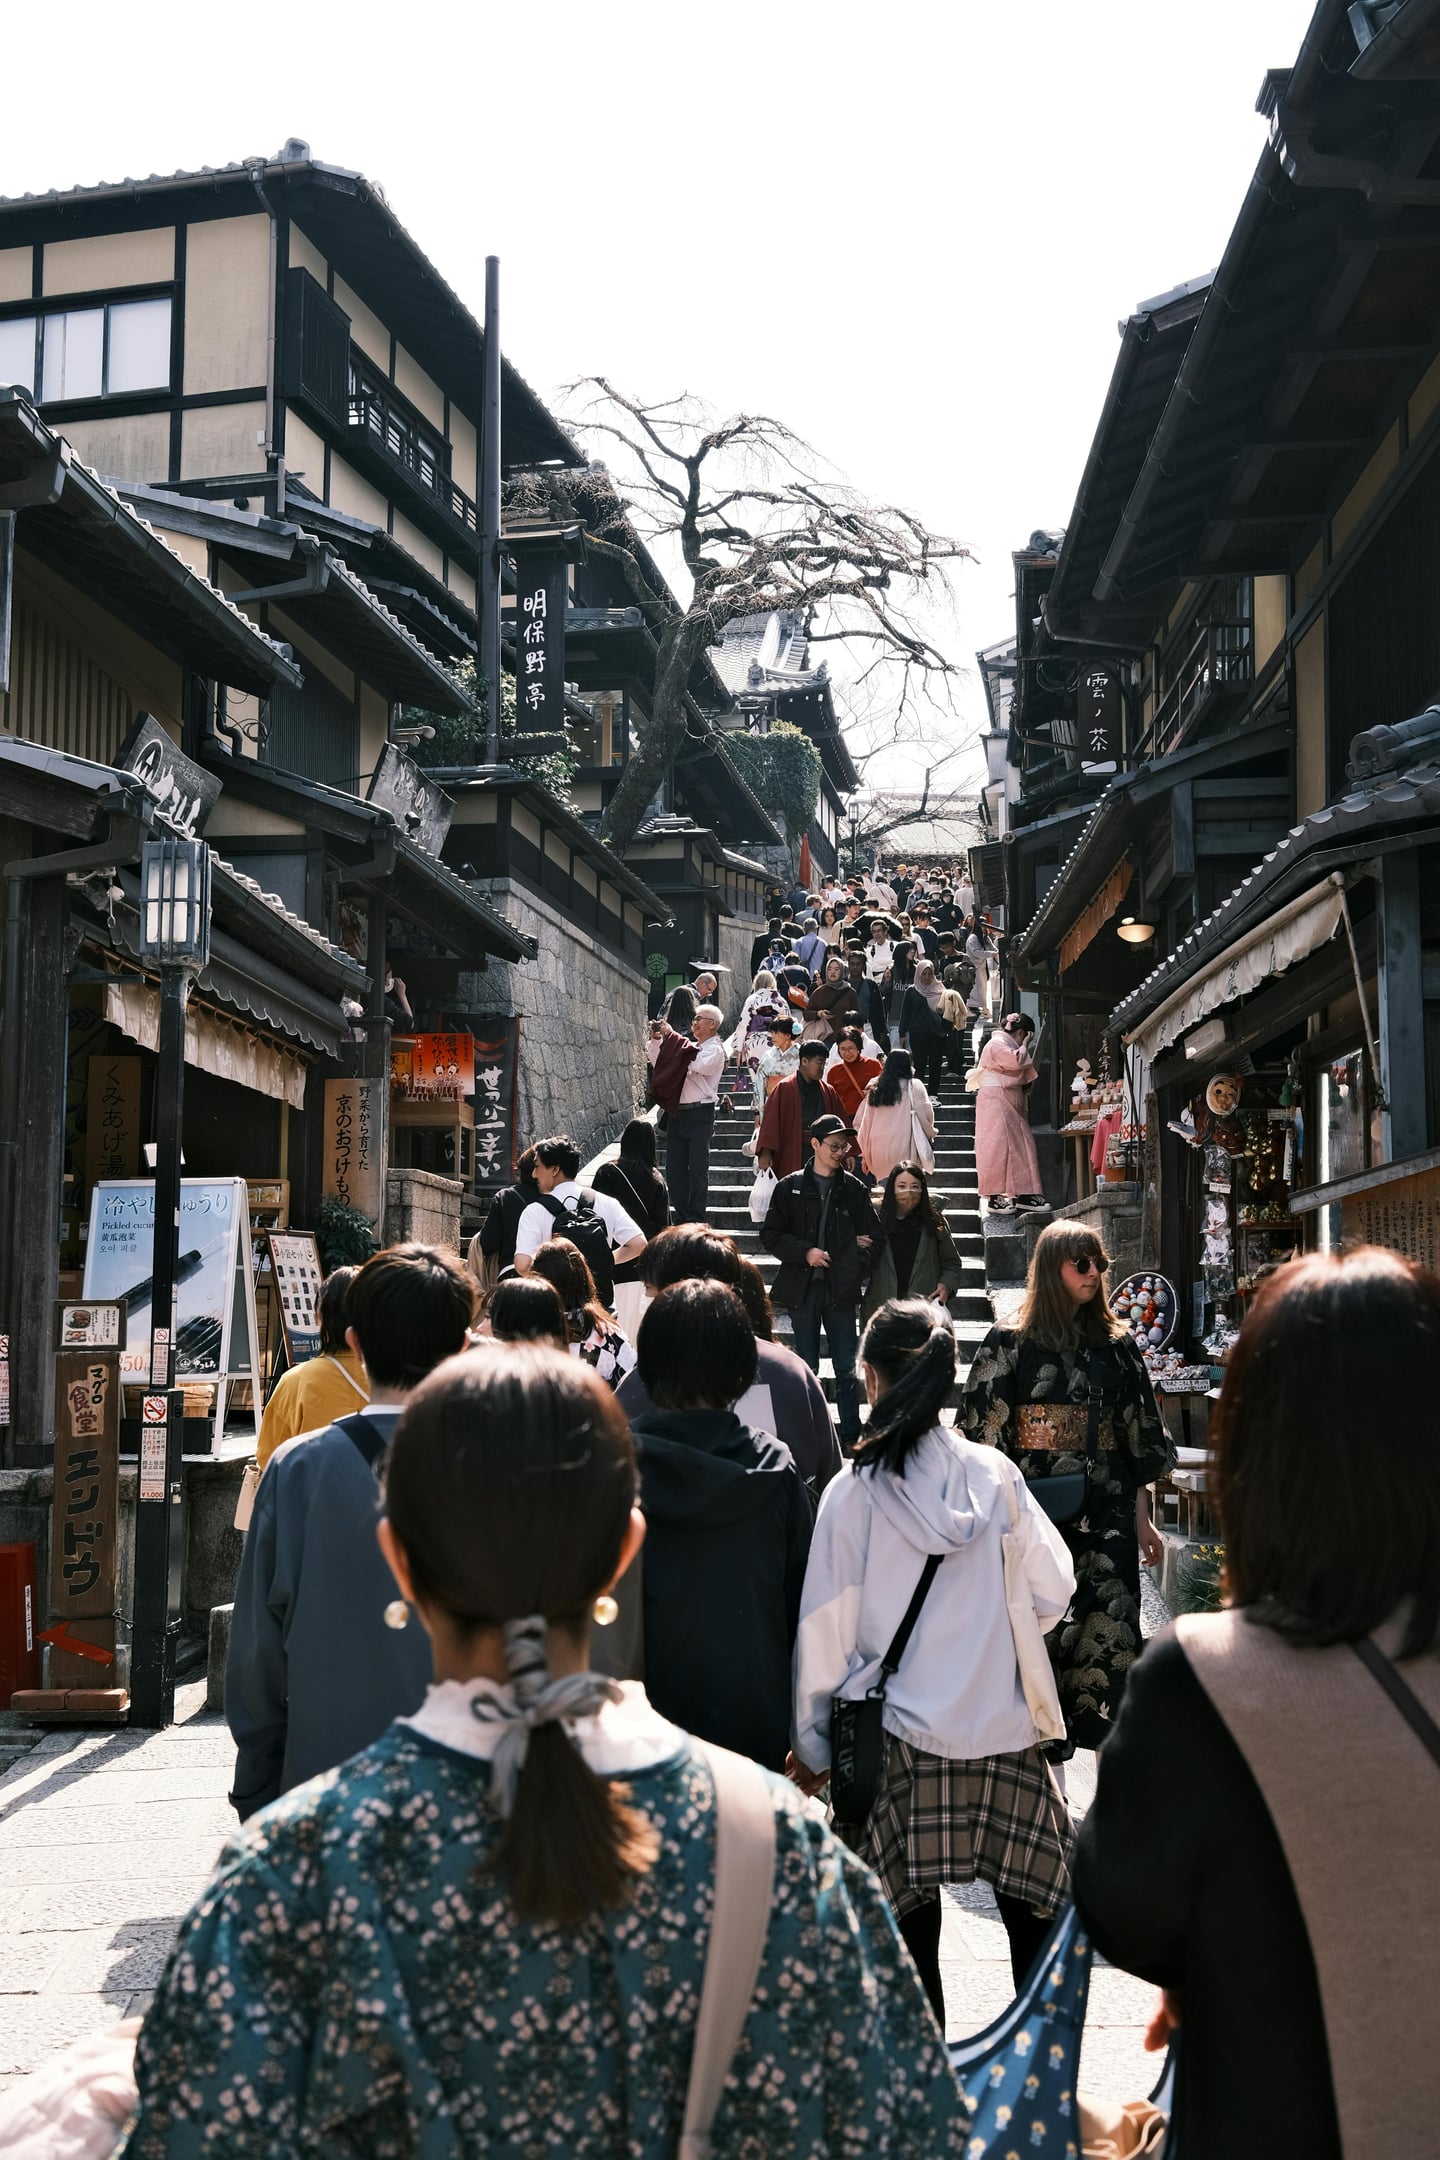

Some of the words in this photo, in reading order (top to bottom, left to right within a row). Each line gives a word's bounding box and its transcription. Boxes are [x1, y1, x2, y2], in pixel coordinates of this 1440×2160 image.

[523, 588, 547, 711] 明保野亭
[1086, 672, 1109, 752] 雲ノ茶
[335, 1094, 353, 1206] 京のおつけもの
[358, 1086, 371, 1171] 野菜から育てた
[102, 1221, 131, 1230] Pickled
[104, 1192, 229, 1217] 冷やしゅうり
[69, 1385, 98, 1434] 食堂
[90, 1367, 108, 1405] マグロ
[62, 1450, 104, 1596] エンドウ
